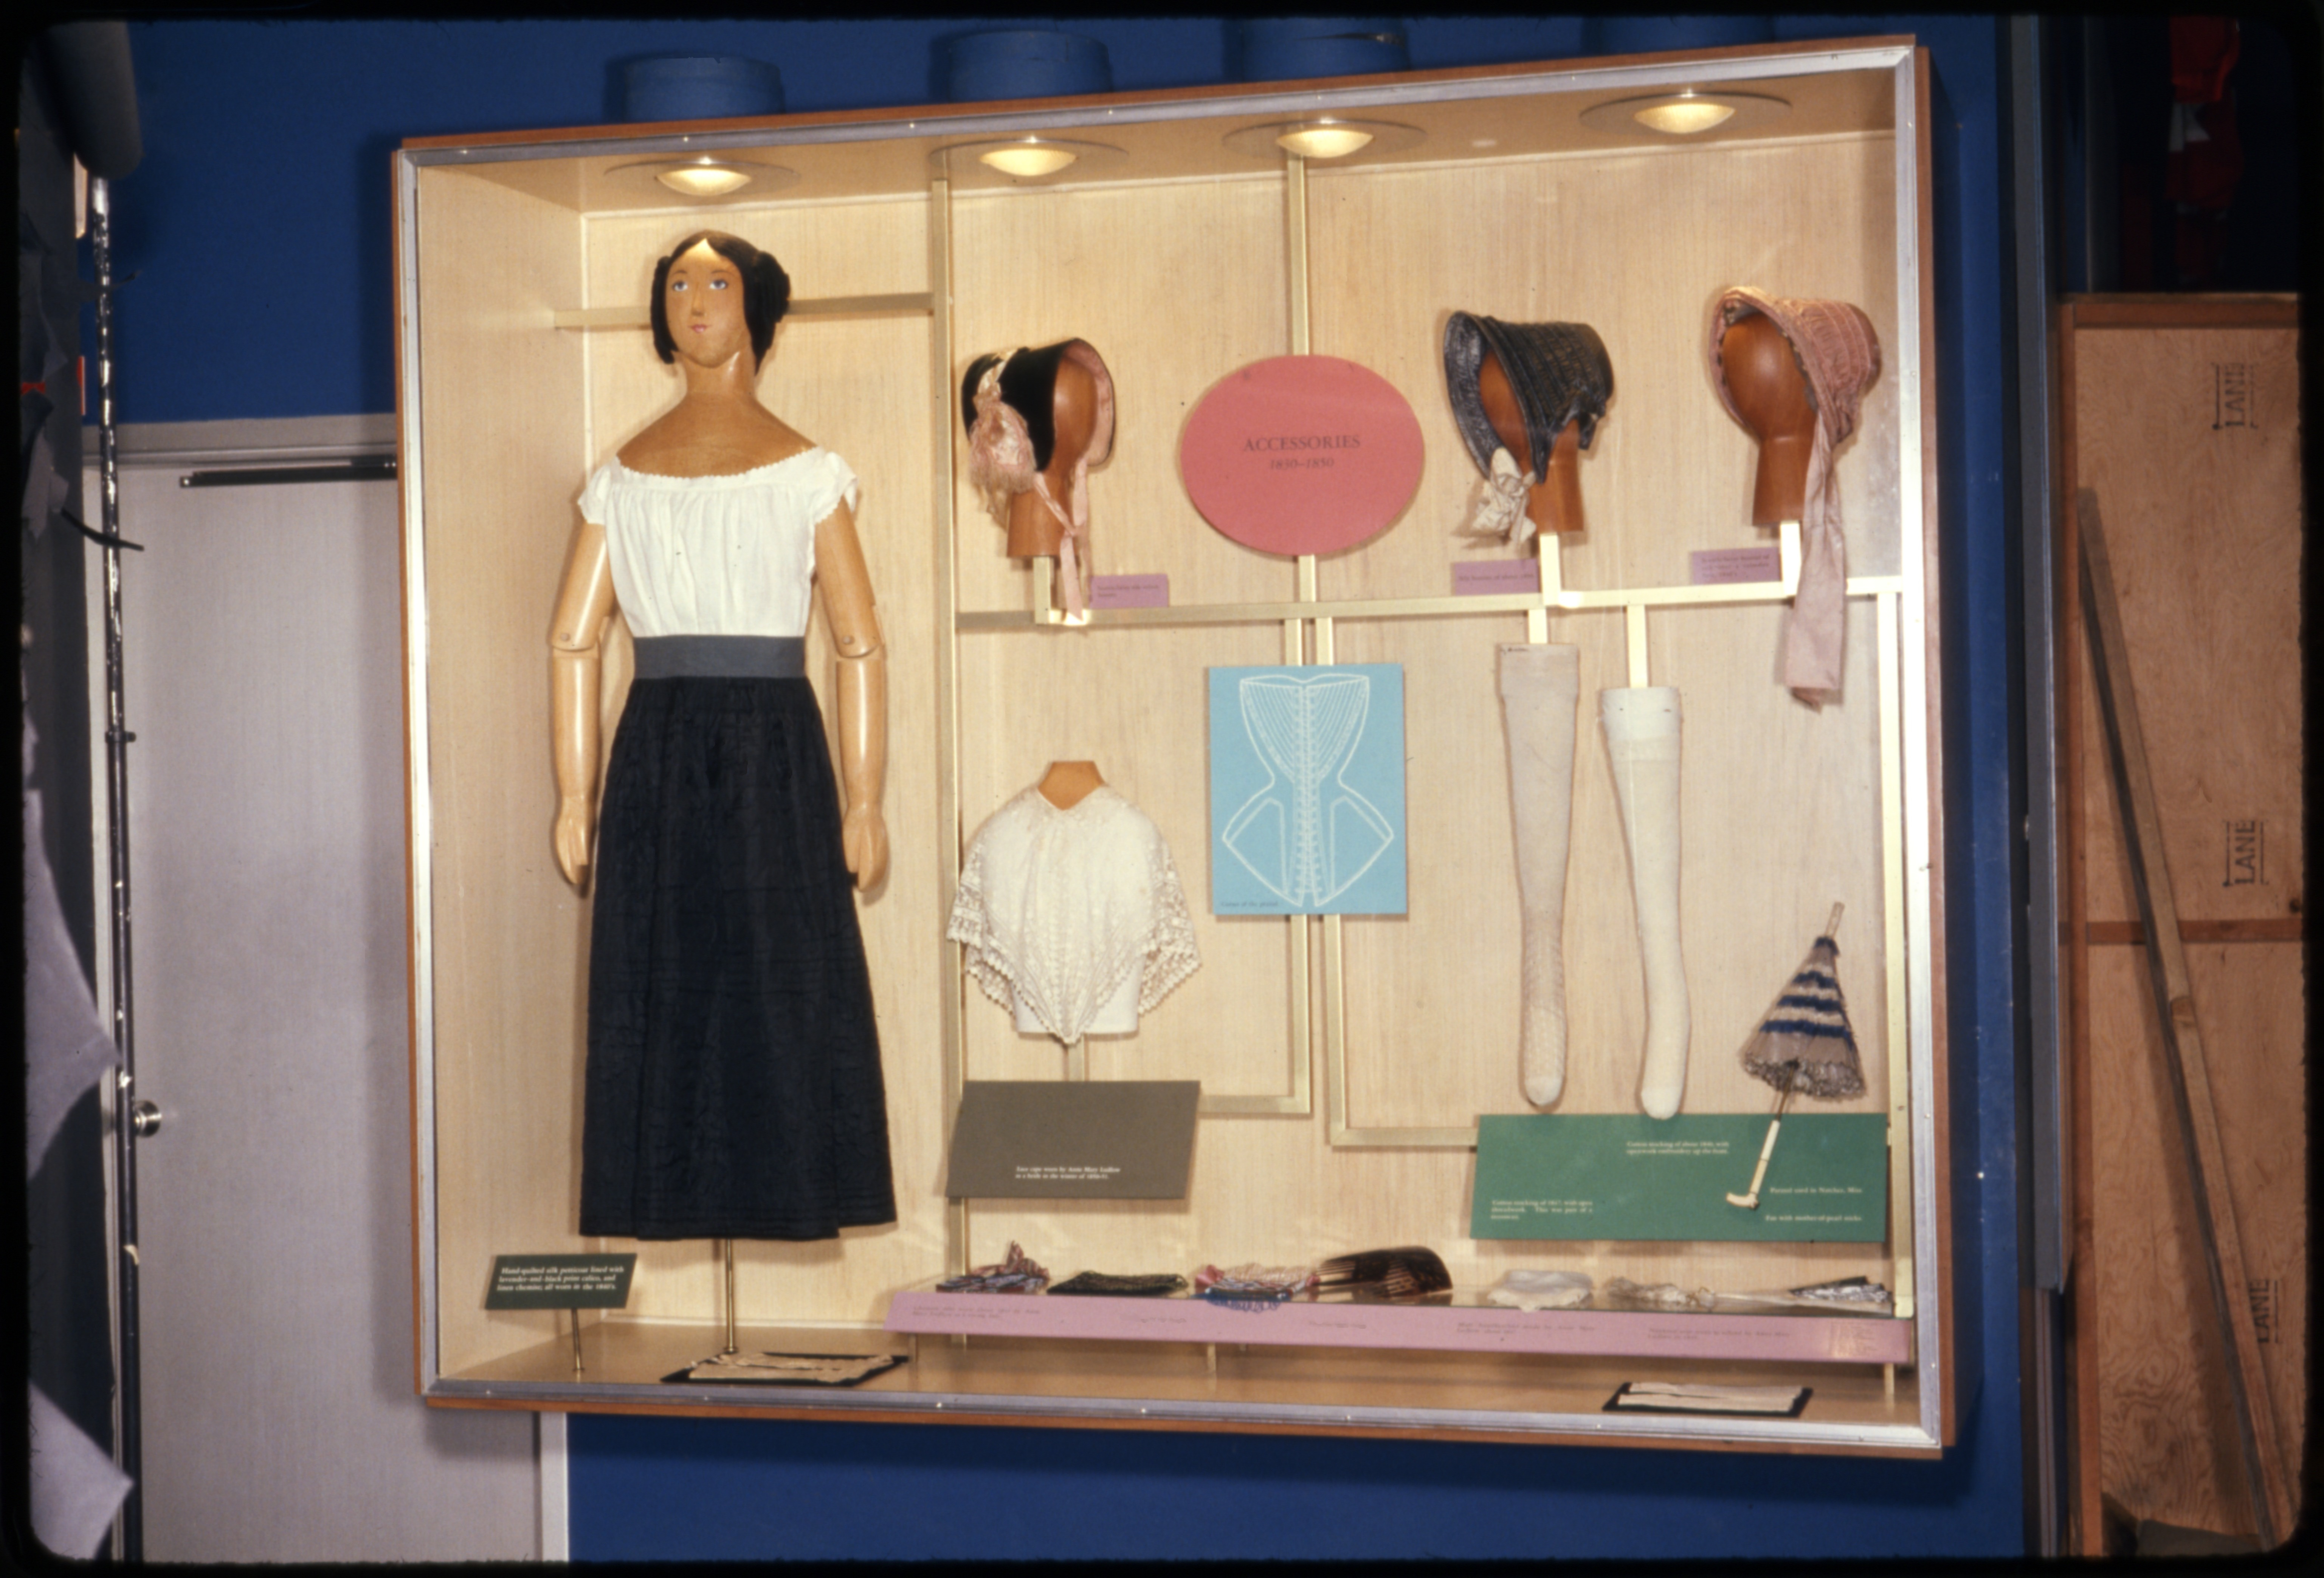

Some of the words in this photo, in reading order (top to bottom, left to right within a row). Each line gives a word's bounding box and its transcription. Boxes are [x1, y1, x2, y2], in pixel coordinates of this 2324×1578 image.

[2225, 362, 2245, 427] LANE
[1243, 434, 1361, 452] ACCESSORIES
[2234, 819, 2255, 884] LANE
[501, 1267, 545, 1276] Hand-quilted
[559, 1267, 589, 1275] petticoat
[563, 1274, 580, 1284] print
